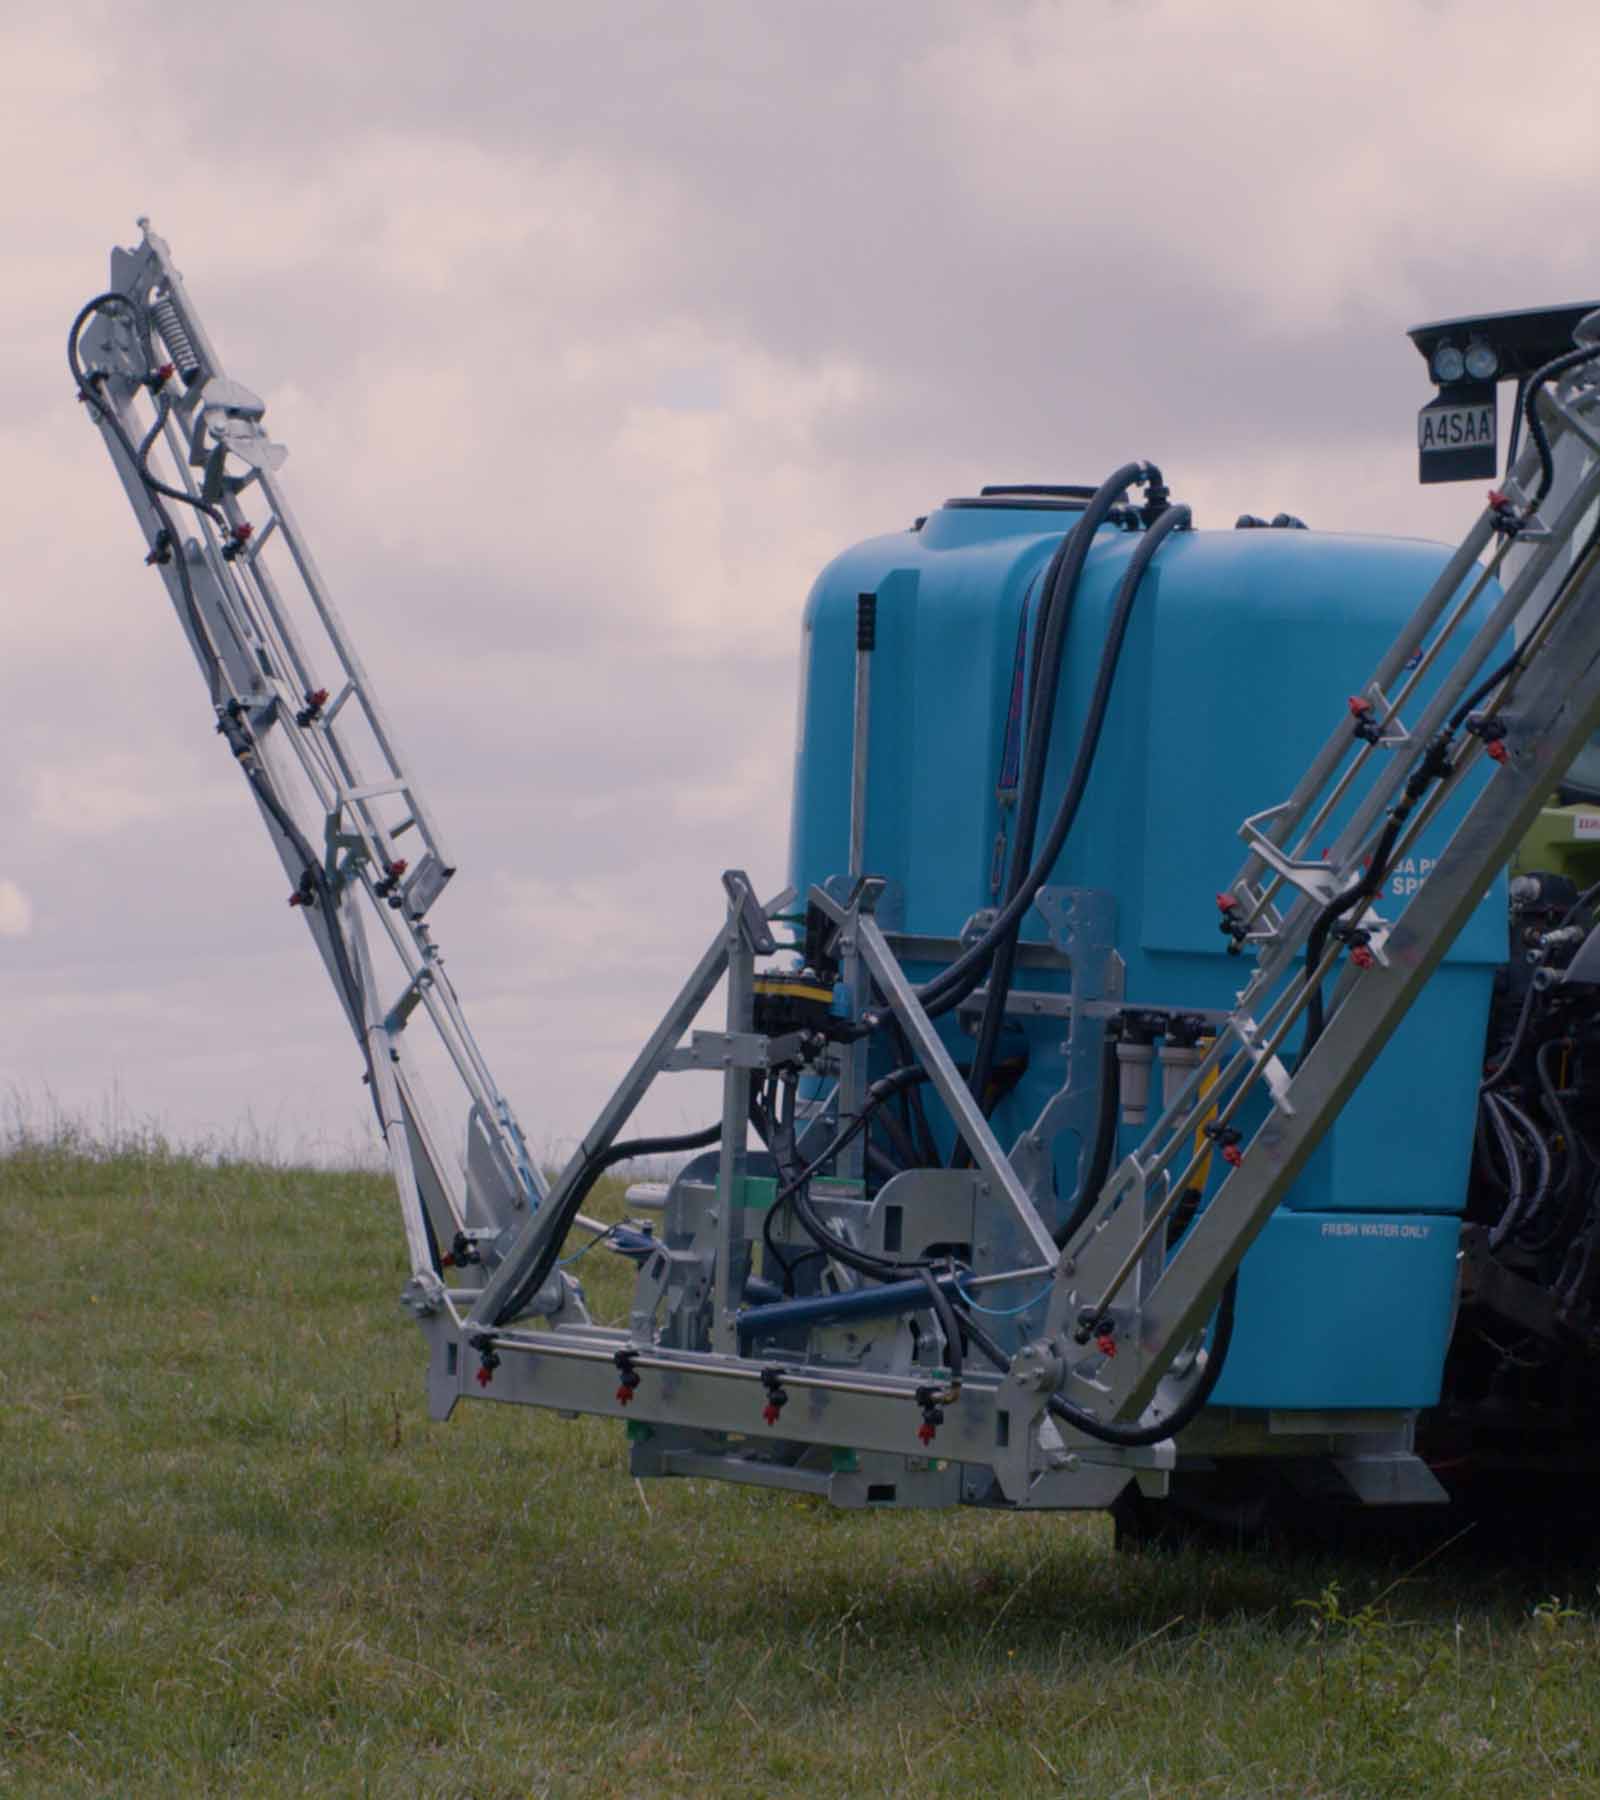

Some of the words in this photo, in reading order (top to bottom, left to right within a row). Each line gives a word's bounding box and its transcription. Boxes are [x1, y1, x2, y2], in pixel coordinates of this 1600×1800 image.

[1423, 411, 1491, 447] A4SAA
[1320, 1222, 1358, 1237] FRESH
[1360, 1223, 1399, 1238] WATER
[1400, 1224, 1431, 1239] ONLY
